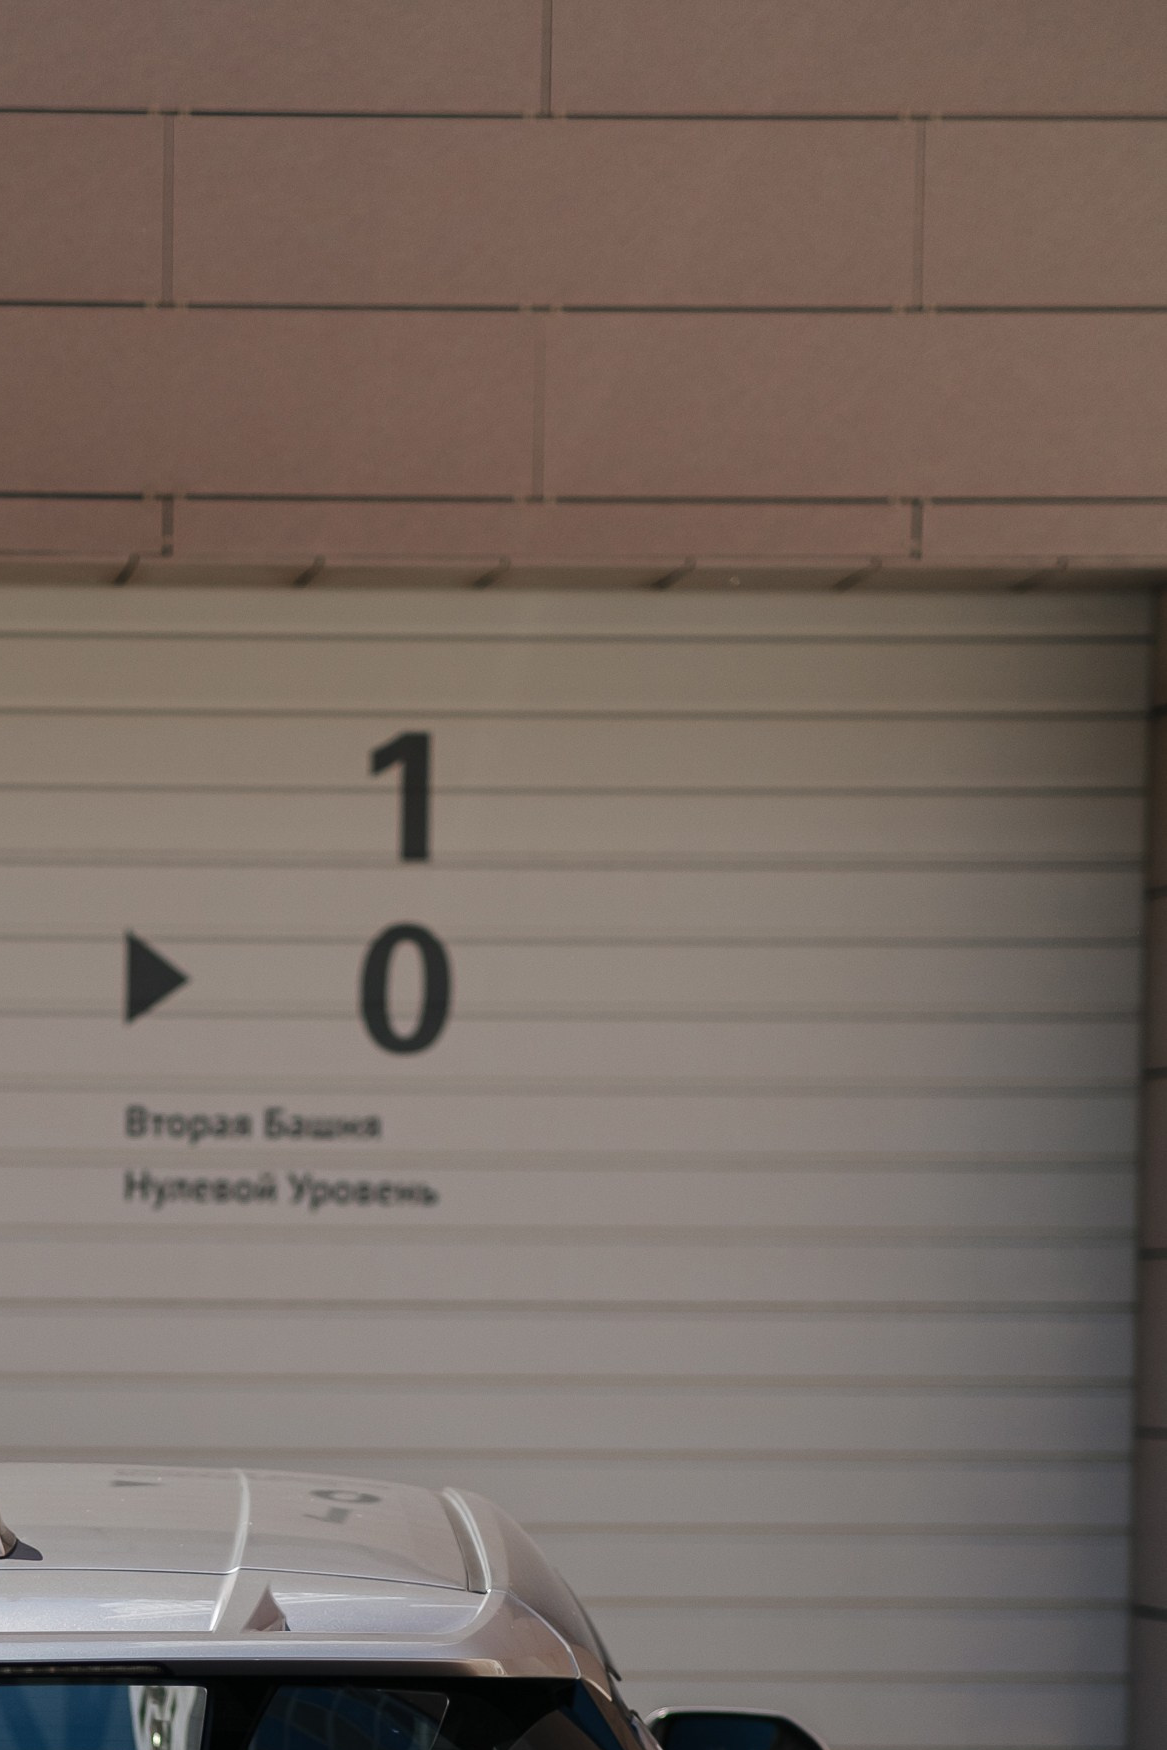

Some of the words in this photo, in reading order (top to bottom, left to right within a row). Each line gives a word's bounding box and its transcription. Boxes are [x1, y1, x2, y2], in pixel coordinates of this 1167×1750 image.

[368, 730, 432, 863] 1
[359, 922, 452, 1058] 0
[124, 1104, 253, 1145] Вторая
[264, 1104, 382, 1141] Башня
[123, 1170, 277, 1212] Нулевой
[287, 1170, 440, 1212] Уровень
